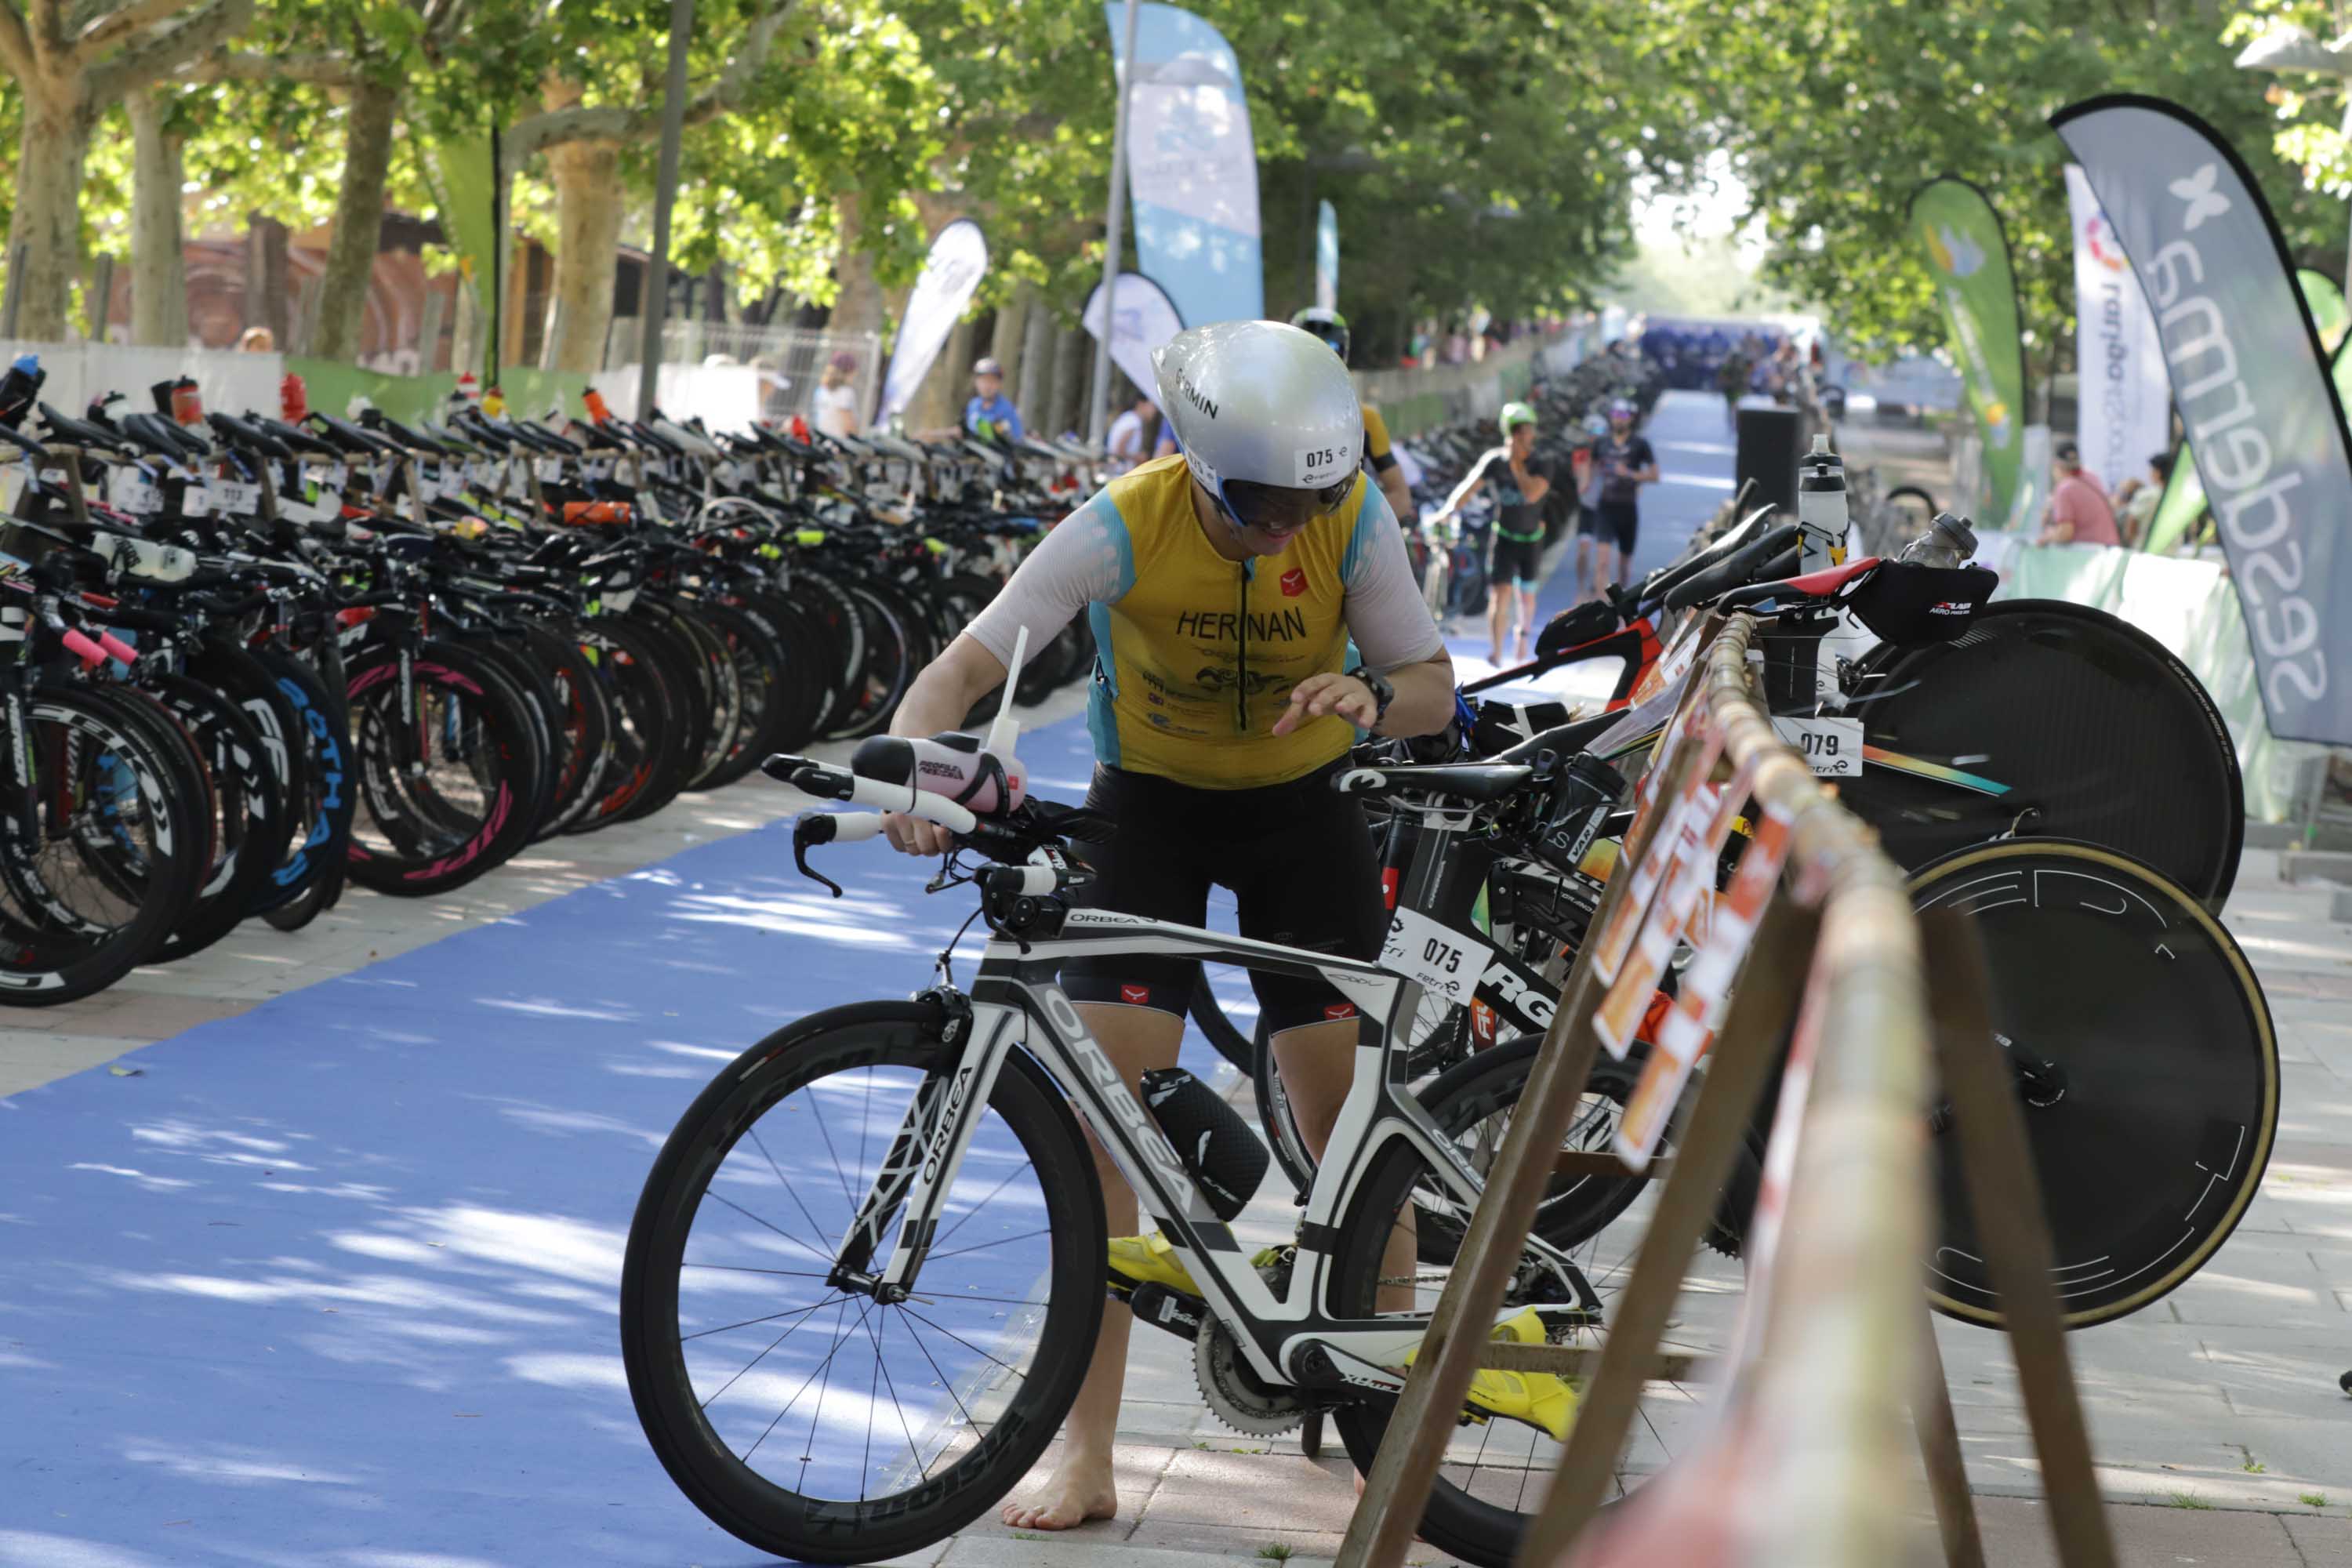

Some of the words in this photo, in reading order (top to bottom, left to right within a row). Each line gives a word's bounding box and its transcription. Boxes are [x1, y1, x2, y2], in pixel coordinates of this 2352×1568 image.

[1175, 368, 1219, 419] GRMIN
[1306, 448, 1333, 468] 075
[1177, 606, 1307, 642] HERNAN
[1800, 733, 1839, 756] 079
[1070, 913, 1139, 924] ORBEA
[1422, 937, 1464, 975] 075
[1045, 989, 1194, 1214] ORBEA
[924, 1066, 974, 1185] ORBEA
